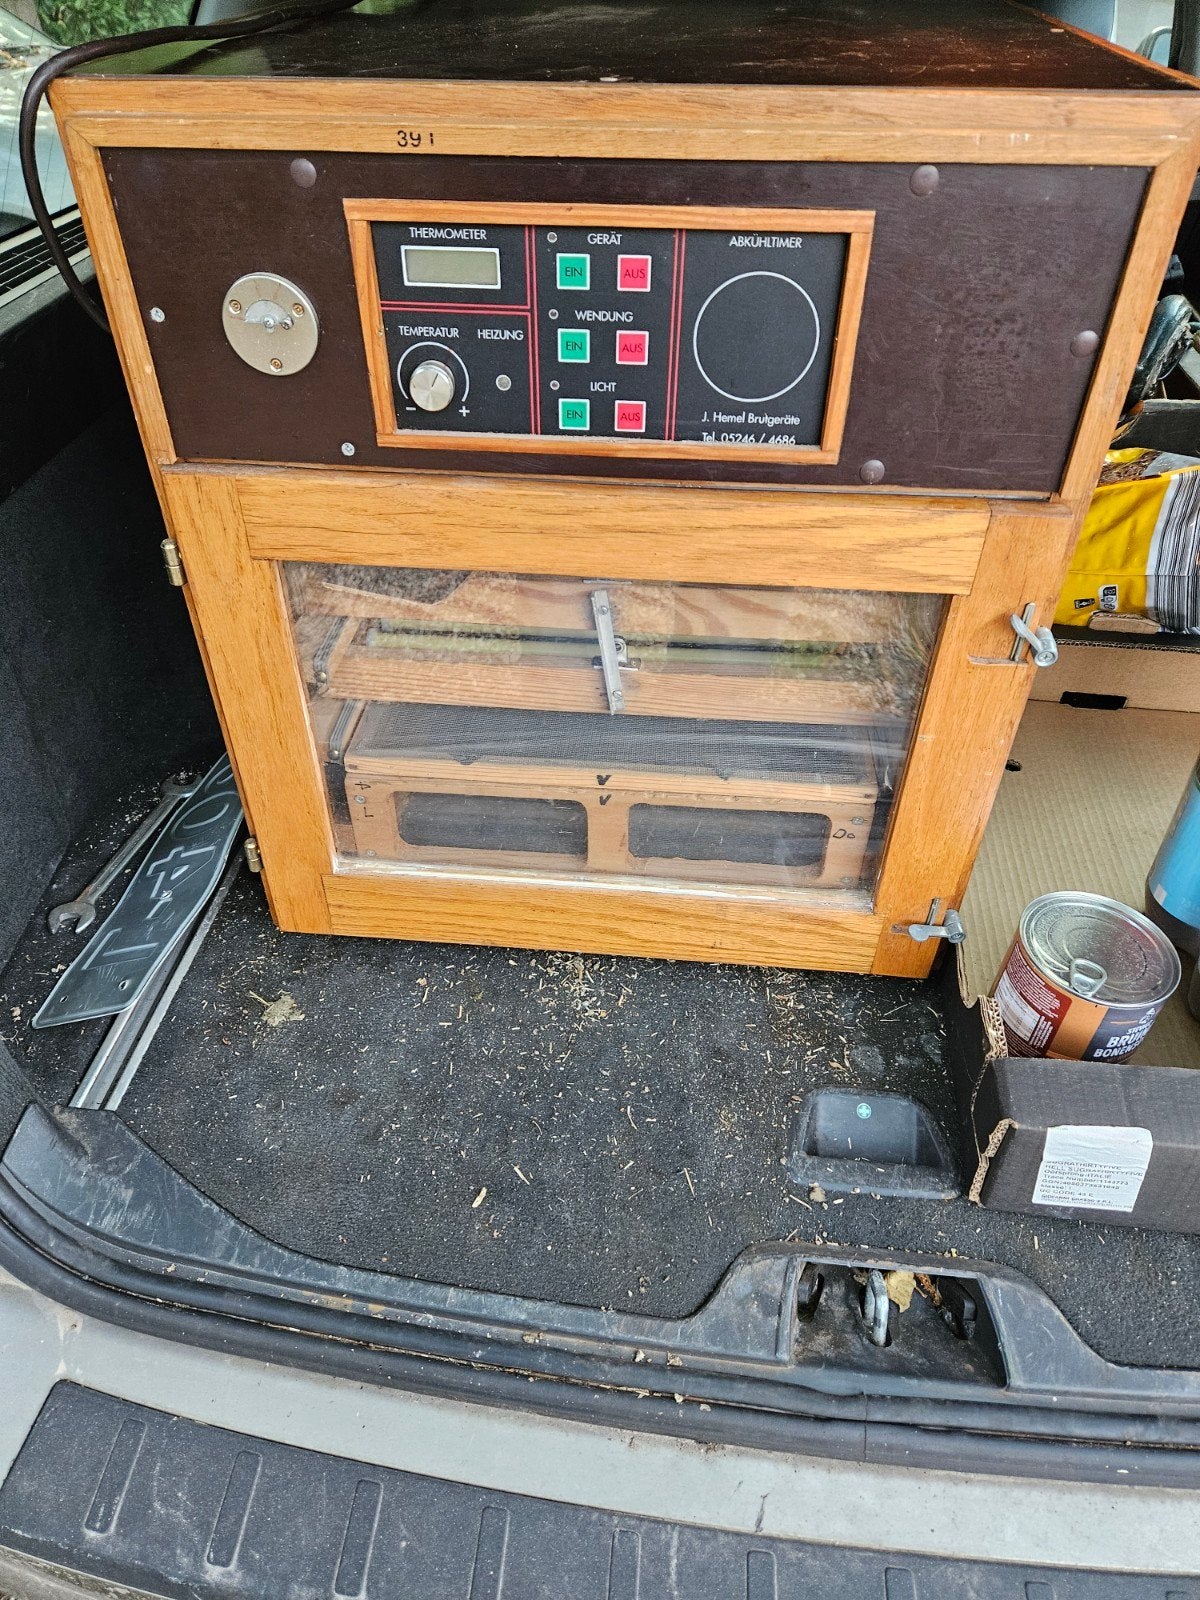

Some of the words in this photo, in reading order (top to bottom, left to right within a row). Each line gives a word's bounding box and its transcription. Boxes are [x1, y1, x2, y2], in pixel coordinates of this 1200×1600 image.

[408, 226, 487, 240] THERMOMETER
[587, 231, 622, 245] GERÄT
[729, 233, 803, 249] ABKÜHLTIMER
[565, 266, 583, 277] EIN
[623, 268, 646, 279] AUS
[575, 310, 634, 323] WENDUNG
[398, 325, 460, 338] TEMPERATUR
[477, 328, 524, 341] HEIZUNG
[565, 340, 583, 351] EIN
[621, 343, 643, 353] AUS
[590, 381, 617, 393] LICHT
[566, 409, 583, 419] EIN
[620, 412, 641, 422] AUS
[702, 411, 709, 423] J.
[713, 411, 746, 424] Hemel
[748, 412, 801, 427] Brutgeräte
[721, 432, 756, 444] 05246
[768, 433, 796, 445] 4686
